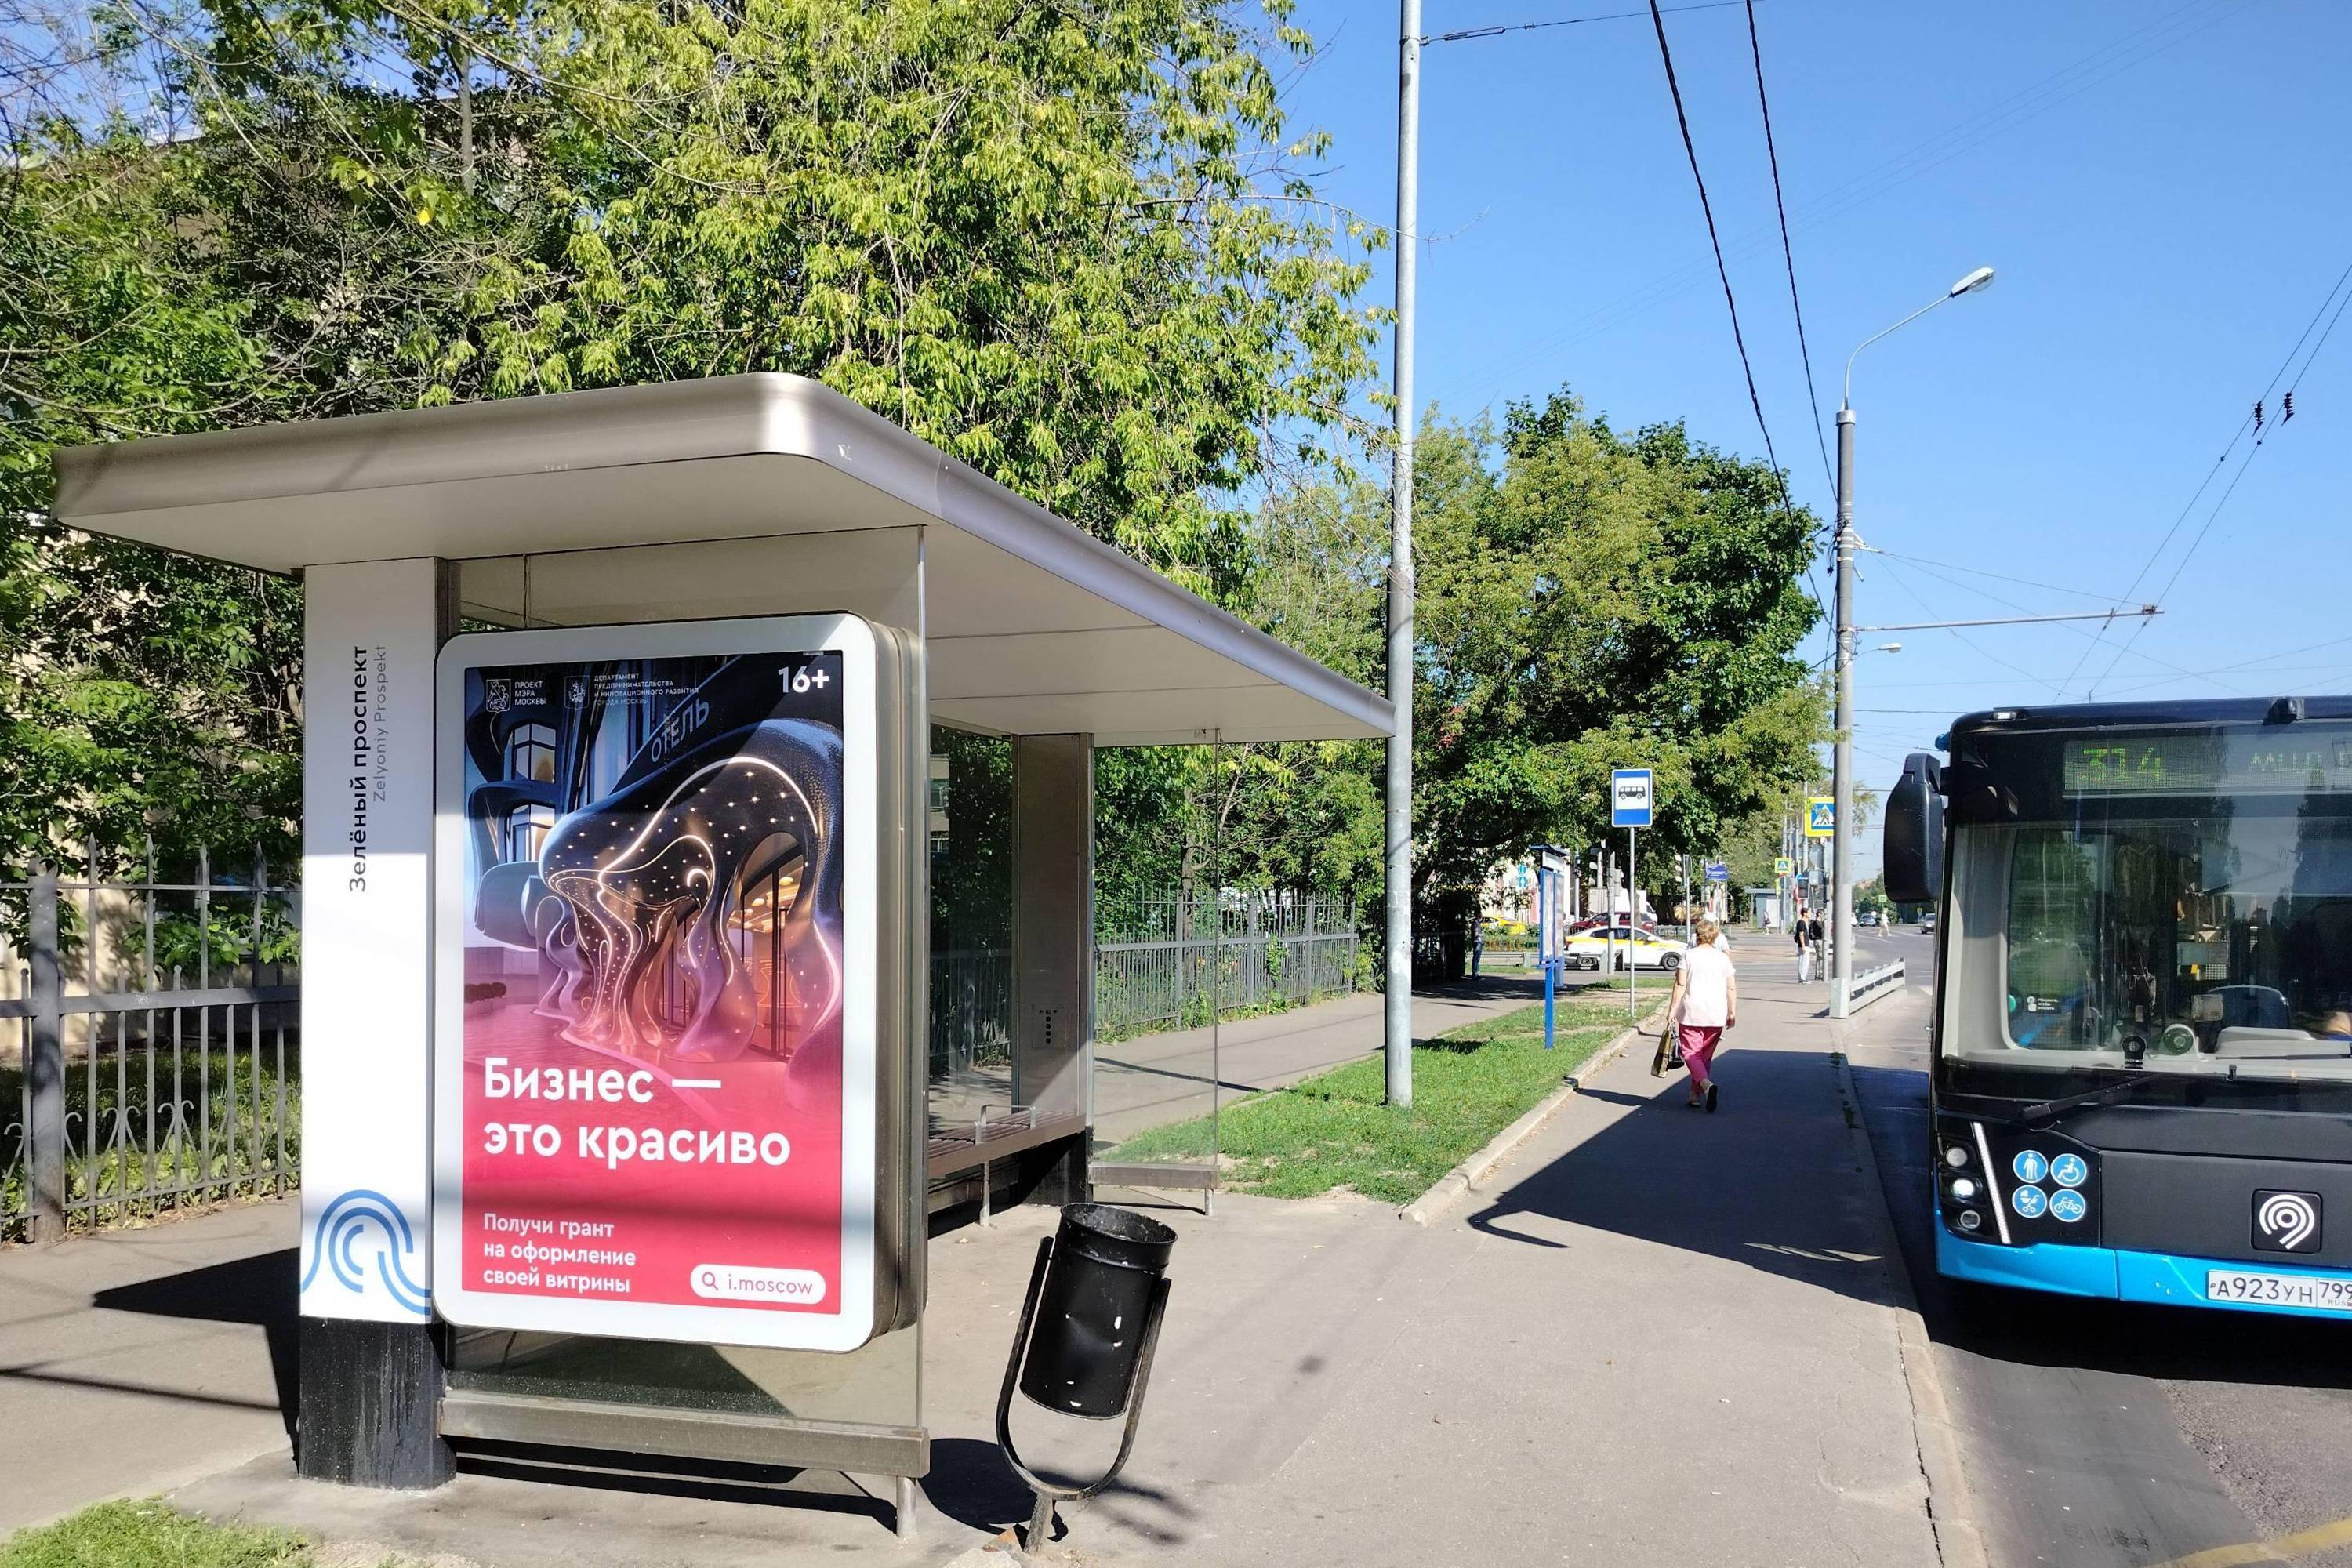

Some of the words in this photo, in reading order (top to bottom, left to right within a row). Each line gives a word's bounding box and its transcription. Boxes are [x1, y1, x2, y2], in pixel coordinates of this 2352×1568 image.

[374, 645, 389, 722] Prospekt
[778, 666, 829, 693] 16+
[354, 646, 370, 767] проспект
[514, 697, 547, 706] МОСКВЫ
[651, 697, 710, 762] ОТЕЛЬ
[373, 728, 389, 802] Zelyoniy
[2082, 746, 2162, 782] 314
[349, 775, 367, 892] Зелёный
[484, 1057, 655, 1103] Бизнес
[484, 1121, 561, 1157] это
[579, 1124, 791, 1170] красиво
[483, 1213, 554, 1237] Получи
[559, 1219, 615, 1239] грант
[483, 1243, 505, 1258] на
[510, 1242, 637, 1267] оформление
[483, 1267, 539, 1287] своей
[546, 1274, 630, 1294] витрины
[728, 1273, 813, 1295] i.moscow
[2216, 1276, 2312, 1303] А923УН
